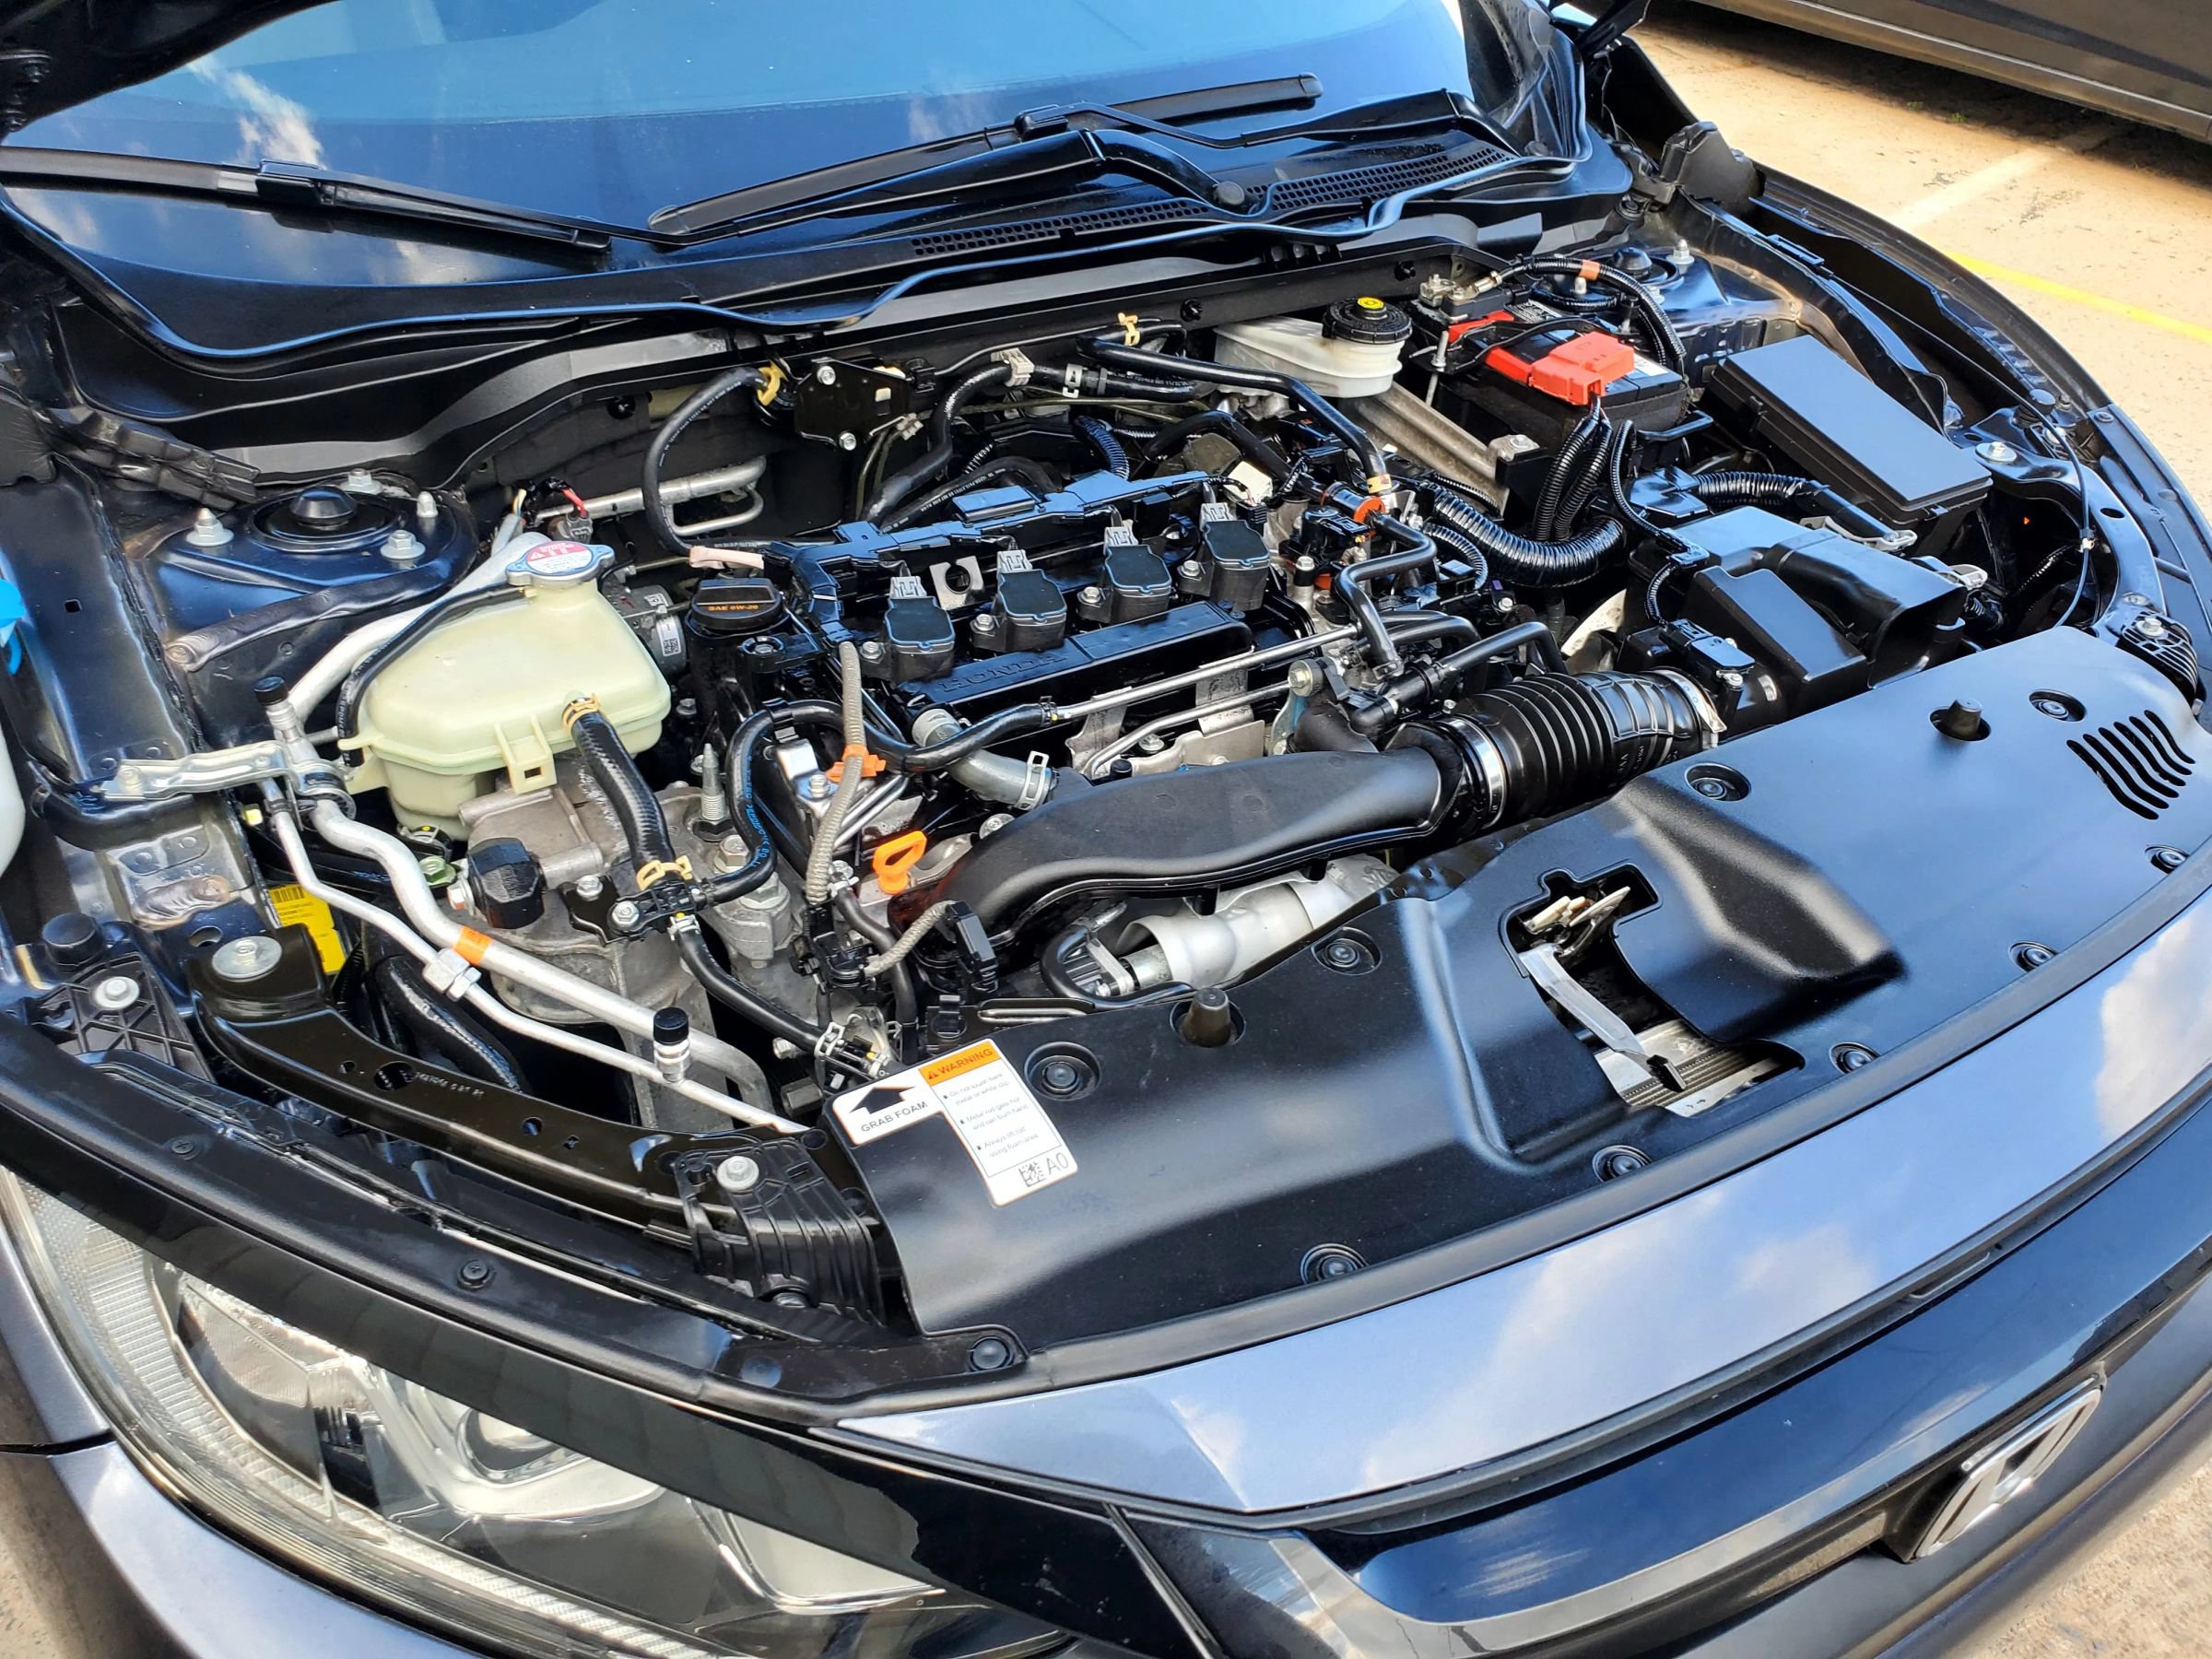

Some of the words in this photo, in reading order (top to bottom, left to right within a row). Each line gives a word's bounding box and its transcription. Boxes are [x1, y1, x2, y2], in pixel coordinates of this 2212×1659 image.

[937, 653, 1066, 692] HONDA
[937, 1048, 993, 1074] WARNING
[861, 1114, 894, 1132] GRAB
[894, 1100, 929, 1119] FOAM
[966, 1110, 984, 1122] Metal
[972, 1121, 985, 1130] and
[984, 1135, 1006, 1149] Always
